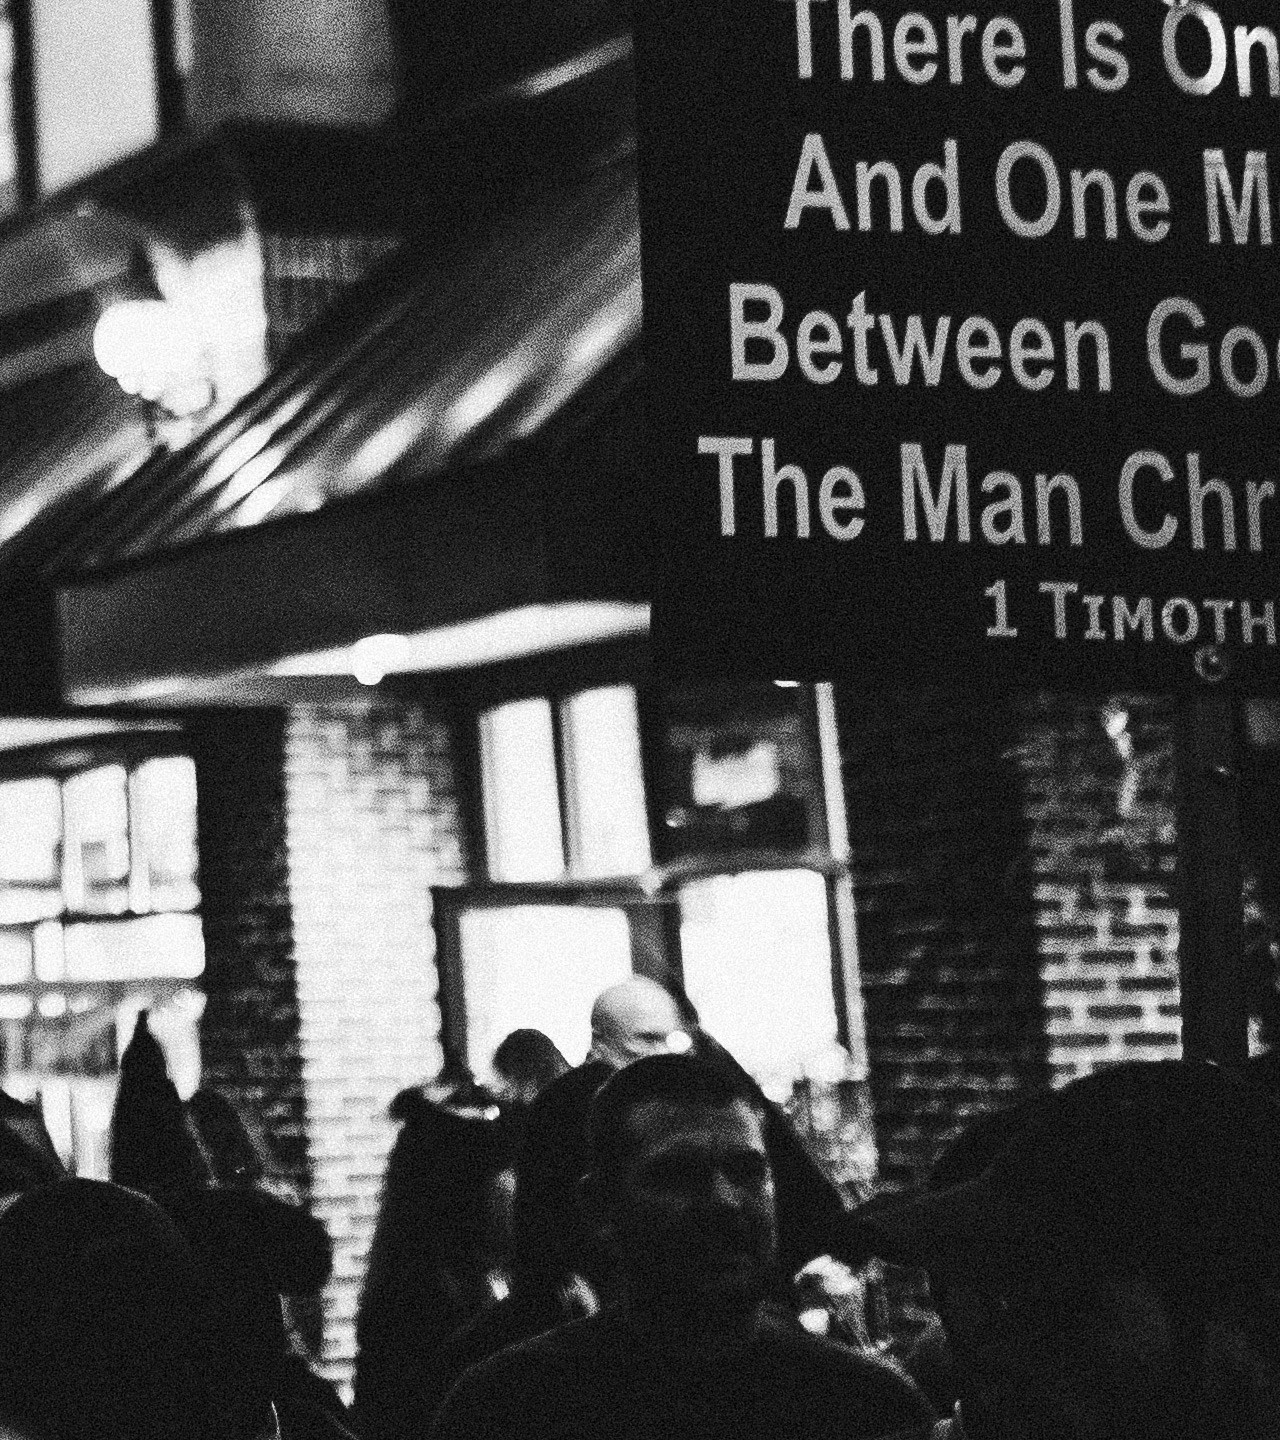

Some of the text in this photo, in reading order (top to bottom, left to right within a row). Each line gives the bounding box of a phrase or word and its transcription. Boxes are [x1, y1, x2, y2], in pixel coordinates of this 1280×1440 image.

[1160, 0, 1280, 96] On
[784, 133, 1272, 244] And One M
[729, 283, 1280, 397] Between Go
[697, 436, 1275, 550] The Man Chr
[985, 580, 1018, 637] 1
